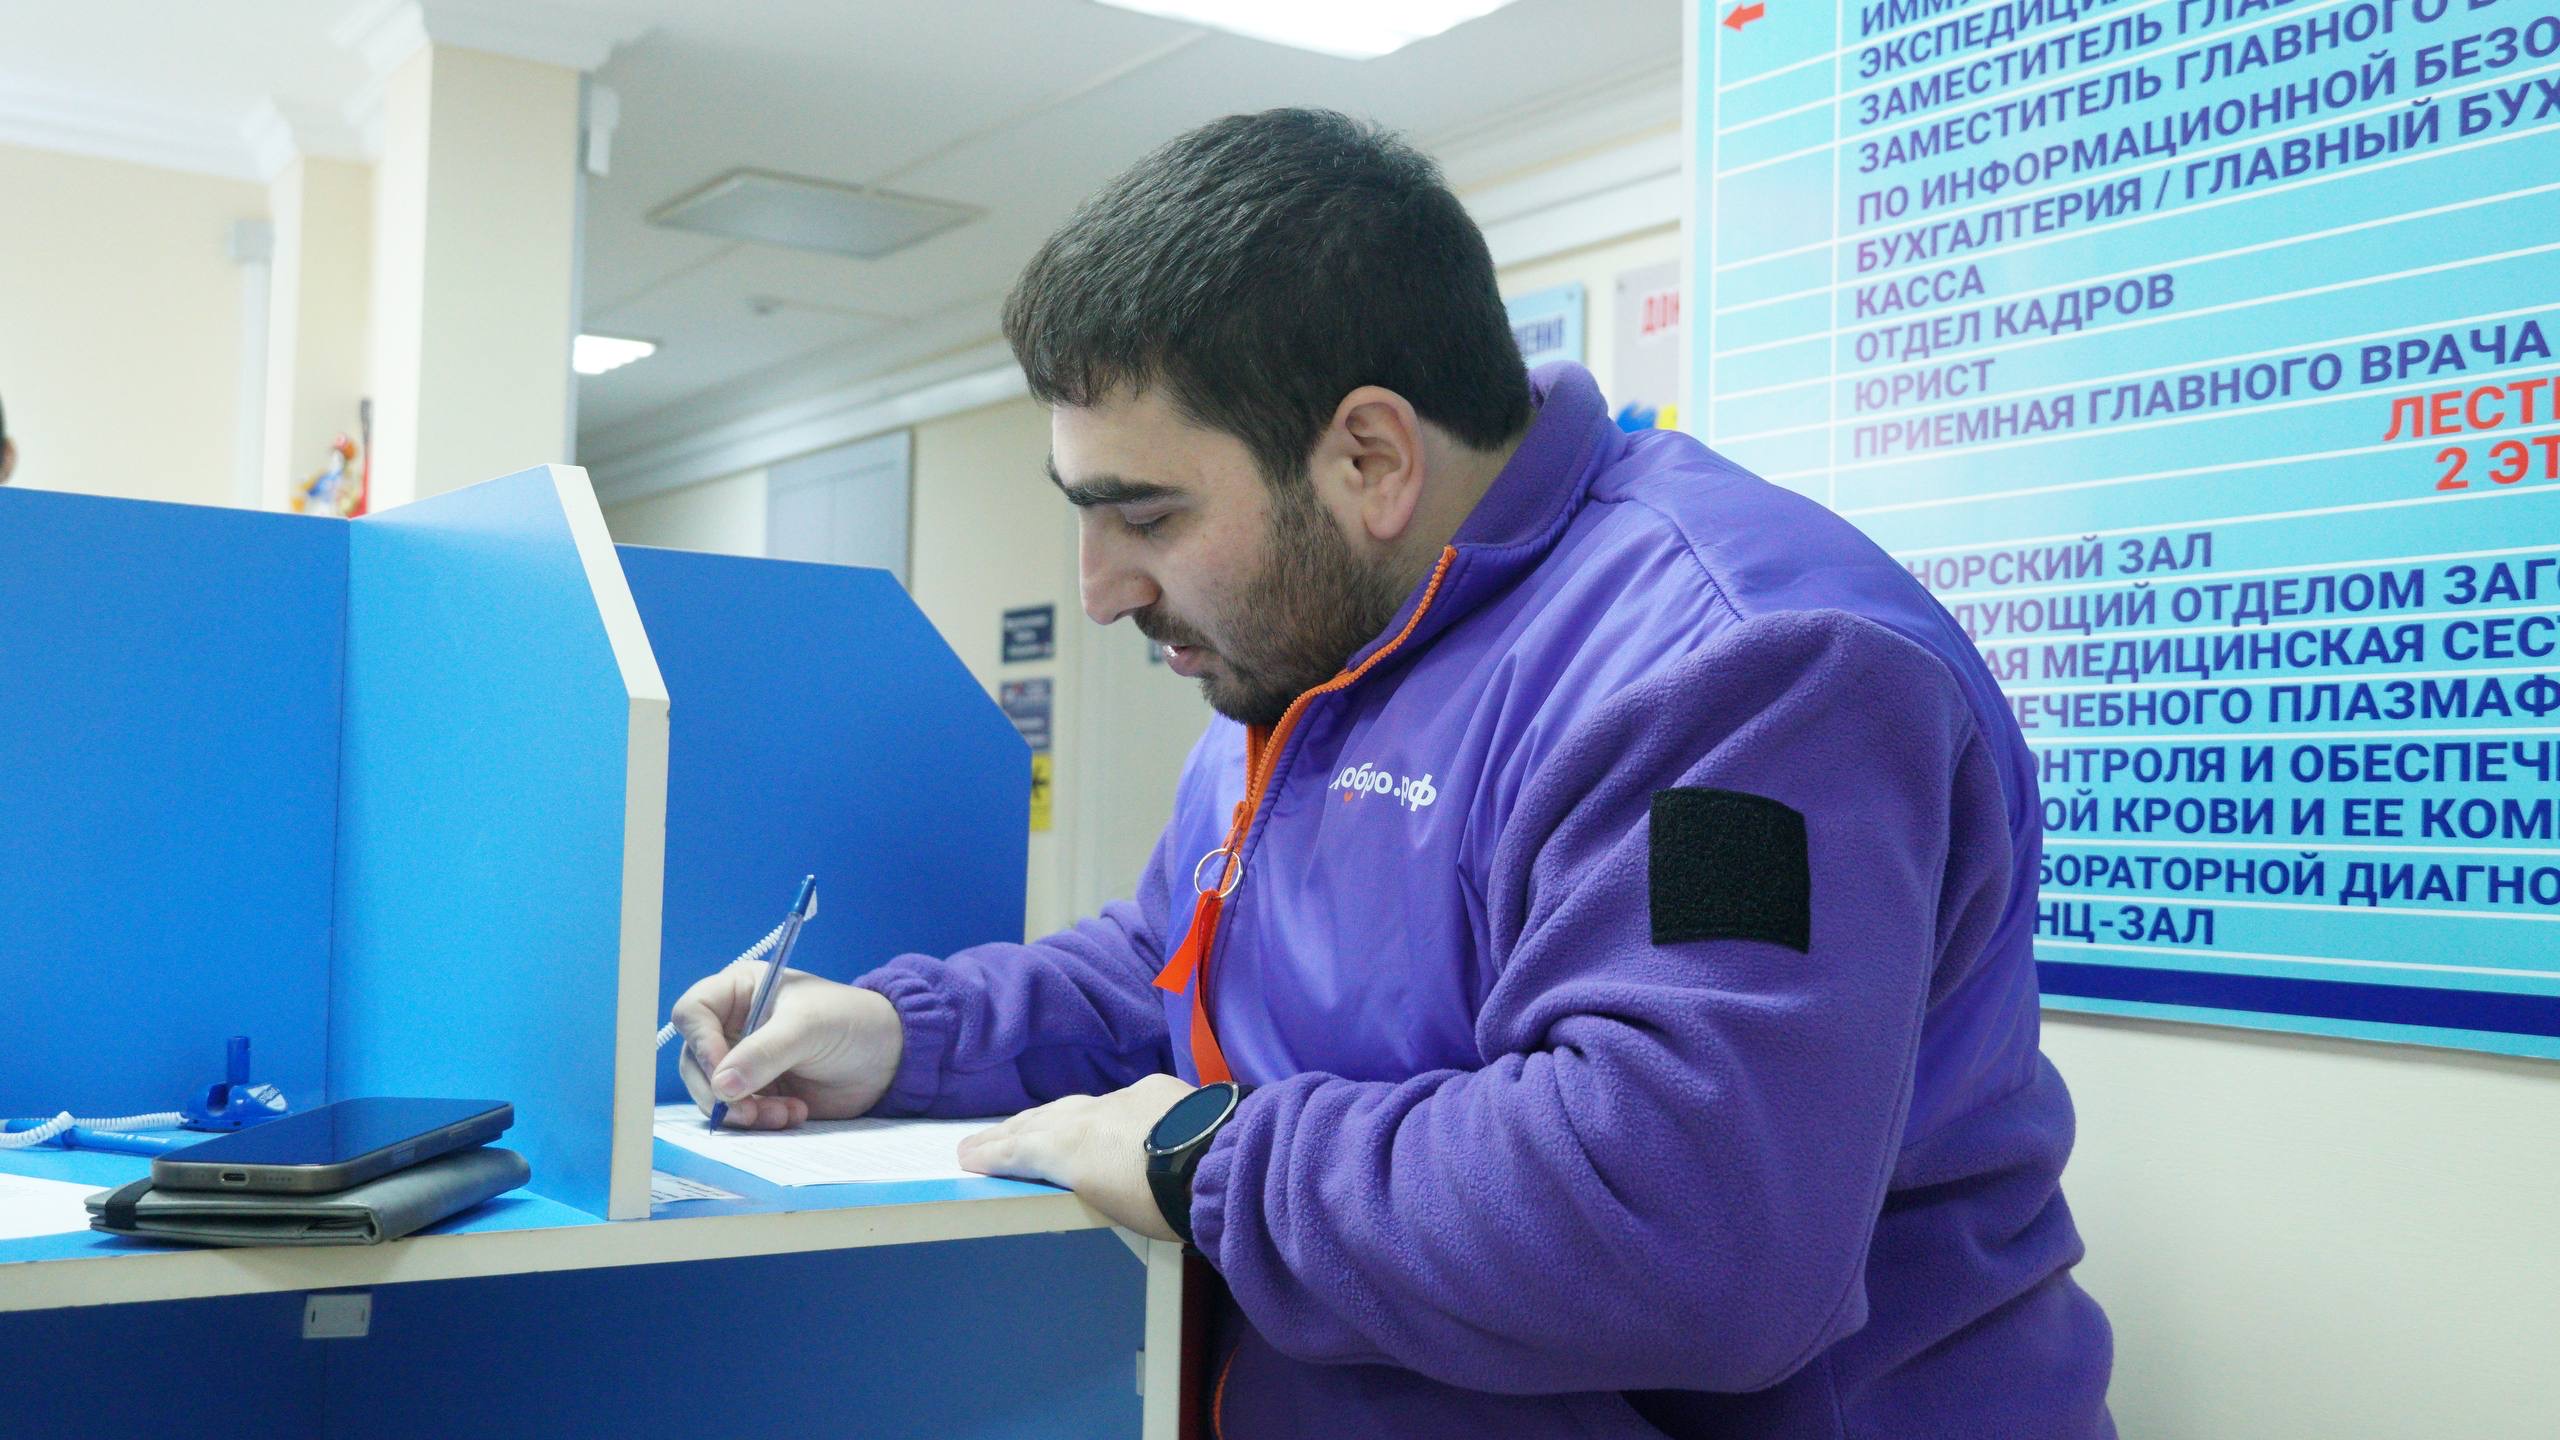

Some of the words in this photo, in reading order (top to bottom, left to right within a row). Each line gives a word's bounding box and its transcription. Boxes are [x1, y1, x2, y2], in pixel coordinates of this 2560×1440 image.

[1859, 0, 2118, 79] ЭКСПЕДИЦ
[1862, 0, 1967, 36] ИМ
[1859, 12, 2162, 125] ЗАМЕСТИТЕЛЬ
[1859, 66, 2162, 173] ЗАМЕСТИТЕЛЬ
[2176, 0, 2448, 90] ГЛАВНОГО
[1858, 185, 1909, 225] ПО
[1921, 48, 2395, 210] ИНФОРМАЦИОННОЙ
[2415, 15, 2560, 88] БЕЗО
[1857, 177, 2141, 272] БУХГАЛТЕРИЯ
[2154, 169, 2171, 210] /
[2185, 96, 2439, 200] ГЛАВНЫЙ
[2458, 77, 2560, 137] БУХ
[1855, 310, 1981, 363] ОТДЕЛ
[1994, 273, 2175, 338] КАДРОВ
[1856, 264, 1985, 319] КАССА
[1854, 394, 2075, 459] ПРИЕМНАЯ
[2088, 353, 2343, 424] ГЛАВНОГО
[2360, 319, 2552, 385] ВРАЧА
[1855, 358, 1995, 412] ЮРИСТ
[2435, 446, 2469, 491] 2
[2487, 434, 2560, 485] ЭТ
[1906, 534, 2103, 590] НОРСКИЙ
[2117, 531, 2212, 573] ЗАЛ
[2171, 568, 2424, 626] ОТДЕЛОМ
[2443, 558, 2560, 605] ЗАГ
[1984, 646, 2028, 681] АЯ
[2043, 623, 2424, 684] МЕДИЦИНСКАЯ
[2442, 615, 2560, 661] СЕС
[2006, 687, 2252, 728] ЕЧЕБНОГО
[2269, 673, 2560, 722] ПЛАЗМАФ
[2032, 746, 2225, 783] НТРОЛЯ
[2241, 746, 2274, 782] И
[2290, 741, 2560, 783] ОБЕСПЕЧ
[2042, 788, 2097, 832] ОЙ
[2113, 797, 2273, 834] КРОВИ
[2291, 798, 2324, 836] И
[2343, 798, 2403, 837] ЕЕ
[2421, 798, 2560, 839] КОМ
[2338, 861, 2560, 907] ДИАГНО
[2034, 902, 2214, 945] НЦ-ЗАЛ
